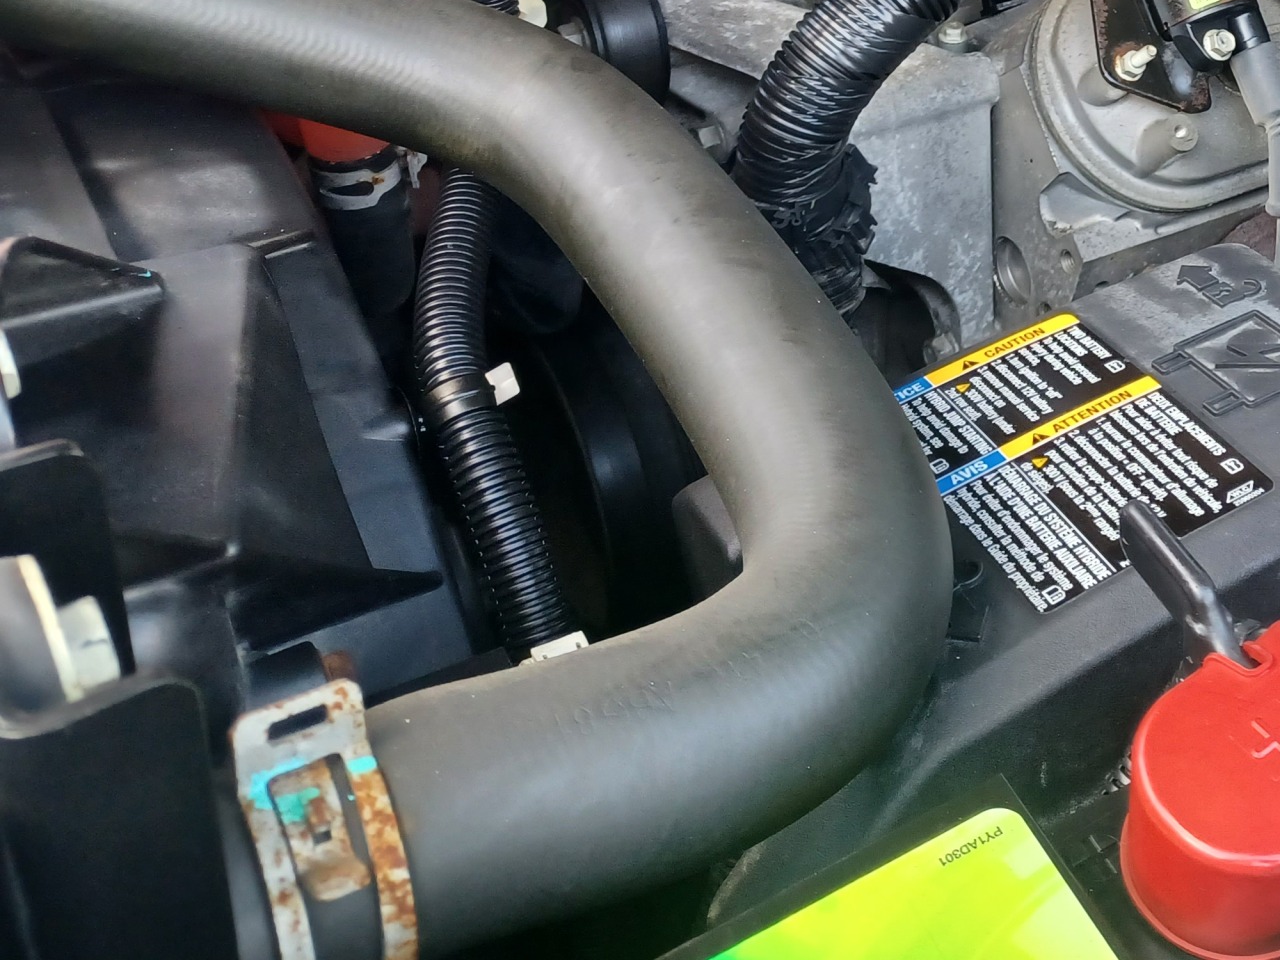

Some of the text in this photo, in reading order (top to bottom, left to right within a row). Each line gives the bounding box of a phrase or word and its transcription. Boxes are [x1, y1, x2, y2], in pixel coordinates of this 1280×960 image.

[983, 326, 1046, 359] CAUTION
[1053, 331, 1088, 356] LOCATIONS
[1066, 325, 1112, 359] TWO BATTERY
[1069, 362, 1101, 383] personal
[911, 396, 968, 453] To help avoid damage to
[923, 390, 992, 455] HYBRID JUMP STARTING
[1015, 402, 1040, 421] service
[1029, 394, 1053, 414] battery
[1052, 390, 1133, 434] ATTENTION
[1134, 397, 1182, 435] DE BATTERIE
[1147, 391, 1226, 455] DEUX EMPLACEMENTS
[929, 436, 943, 448] see
[1058, 442, 1081, 460] retirer
[1075, 457, 1087, 466] le
[1096, 437, 1126, 461] position
[1125, 462, 1145, 475] OFF
[1100, 421, 1127, 442] tourner
[1120, 439, 1132, 448] le
[1127, 446, 1171, 483] commutateur
[1108, 409, 1140, 435] blessures
[1134, 431, 1151, 445] lors
[1145, 443, 1159, 452] de
[1182, 477, 1197, 487] du
[1121, 403, 1140, 417] Pour
[1134, 416, 1155, 430] aider
[1154, 433, 1177, 450] éviter
[1171, 448, 1191, 462] tout
[1183, 460, 1209, 480] risque
[1203, 478, 1218, 488] de
[949, 459, 989, 486] AVIS
[1043, 449, 1065, 463] pour
[1059, 461, 1088, 488] entretien
[1083, 485, 1096, 496] de
[1091, 492, 1103, 503] la
[1073, 435, 1113, 468] déconnecter
[1106, 465, 1118, 475] la
[1112, 472, 1141, 497] batterie
[997, 463, 1111, 580] DÉMARRAGE DU SYSTÈME HYBRIDE
[1072, 494, 1084, 505] la
[956, 486, 1044, 582] hybride, consulter la méthode de
[969, 479, 1073, 590] Pour éviter d'endommager le système
[983, 470, 1097, 589] À L'AIDE D'UNE BATTERIE AUXILIAIRE
[942, 494, 1047, 612] démarrage dans le Guide du propriétaire.
[938, 826, 1003, 867] PY1AD301
